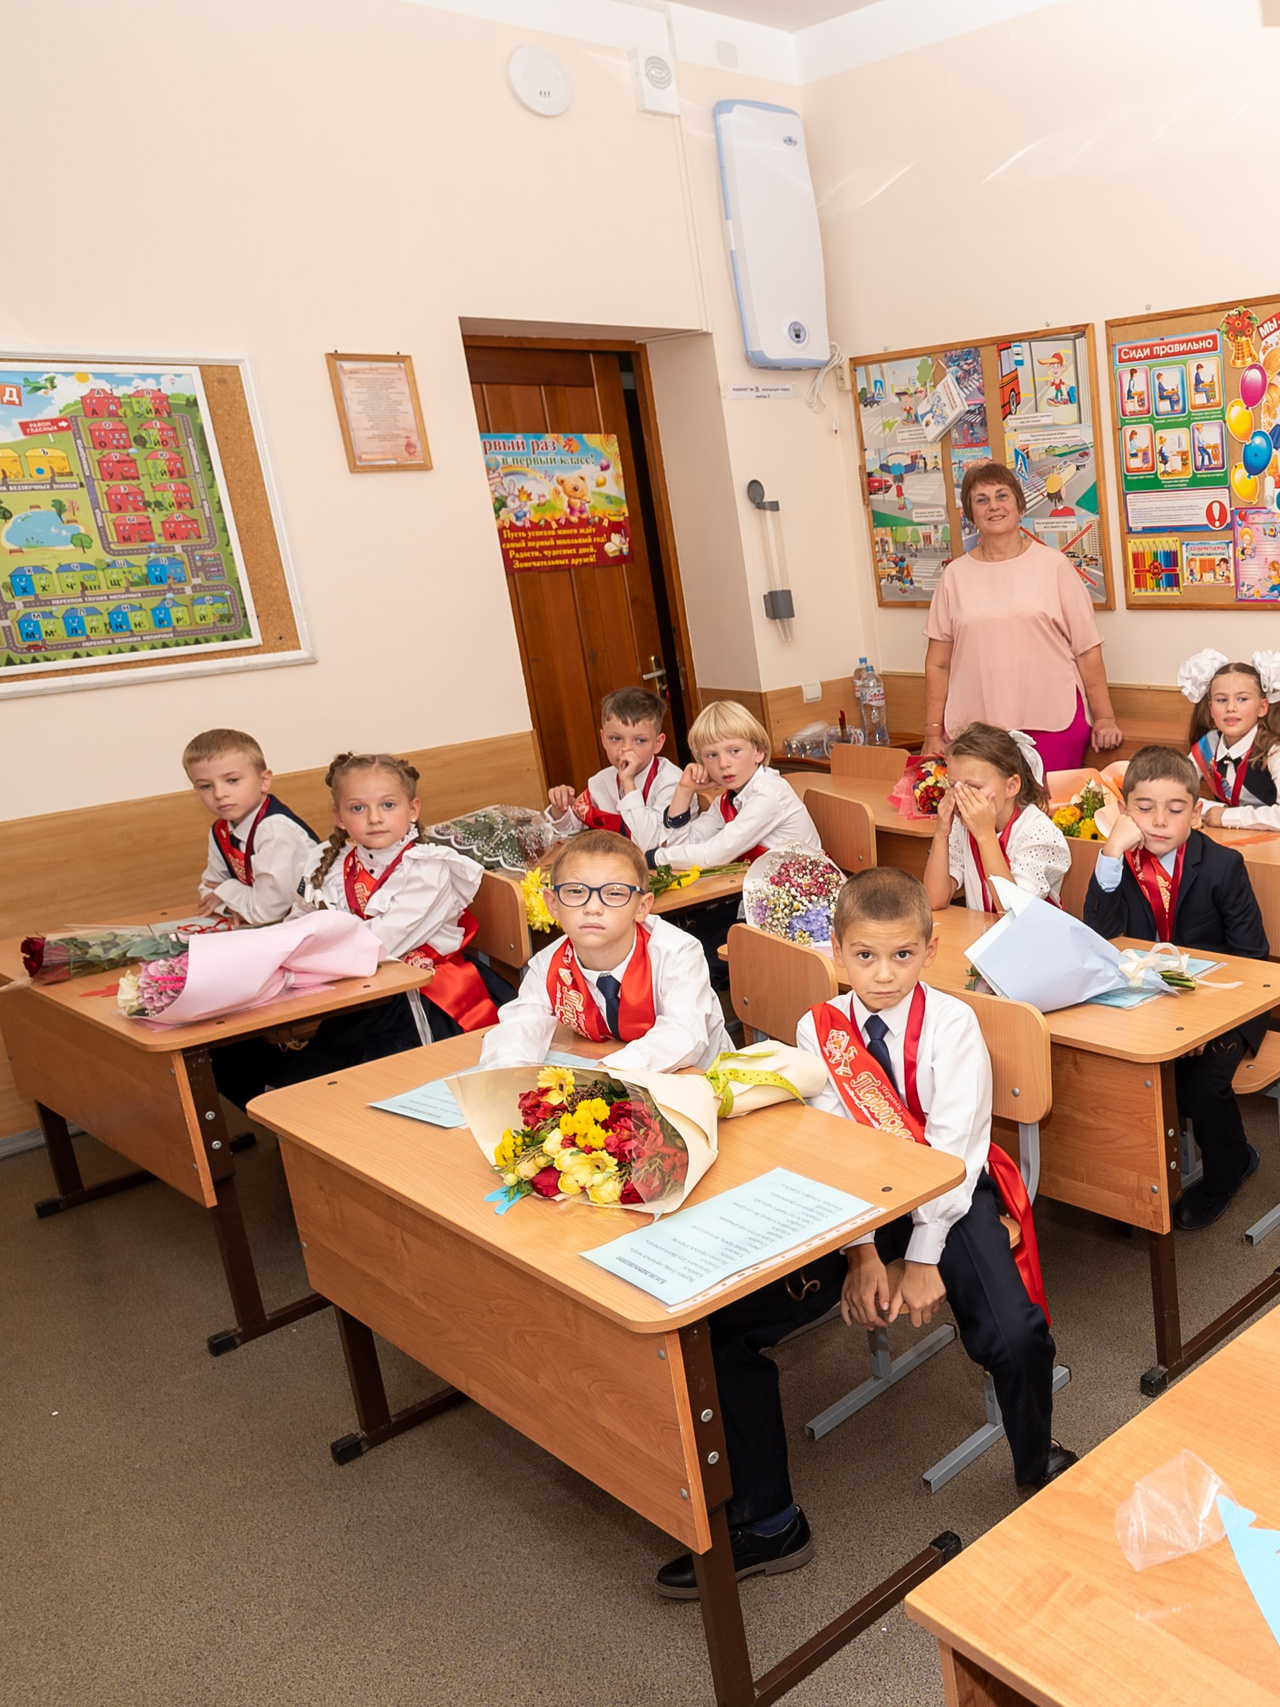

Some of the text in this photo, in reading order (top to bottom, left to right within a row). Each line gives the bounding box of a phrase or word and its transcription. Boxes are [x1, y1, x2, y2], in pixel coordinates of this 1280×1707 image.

[1258, 318, 1278, 338] МЫ
[1121, 339, 1213, 360] Сиди правильно
[3, 386, 20, 405] Д
[530, 440, 556, 455] раз
[512, 455, 556, 468] первый
[560, 454, 595, 465] класс!
[502, 534, 607, 549] самый первый школьный год!
[503, 529, 526, 539] Пусть
[528, 530, 556, 539] успехов
[509, 550, 542, 559] Радости,
[544, 548, 577, 557] чудесных
[513, 555, 596, 569] Замечательных друзей!
